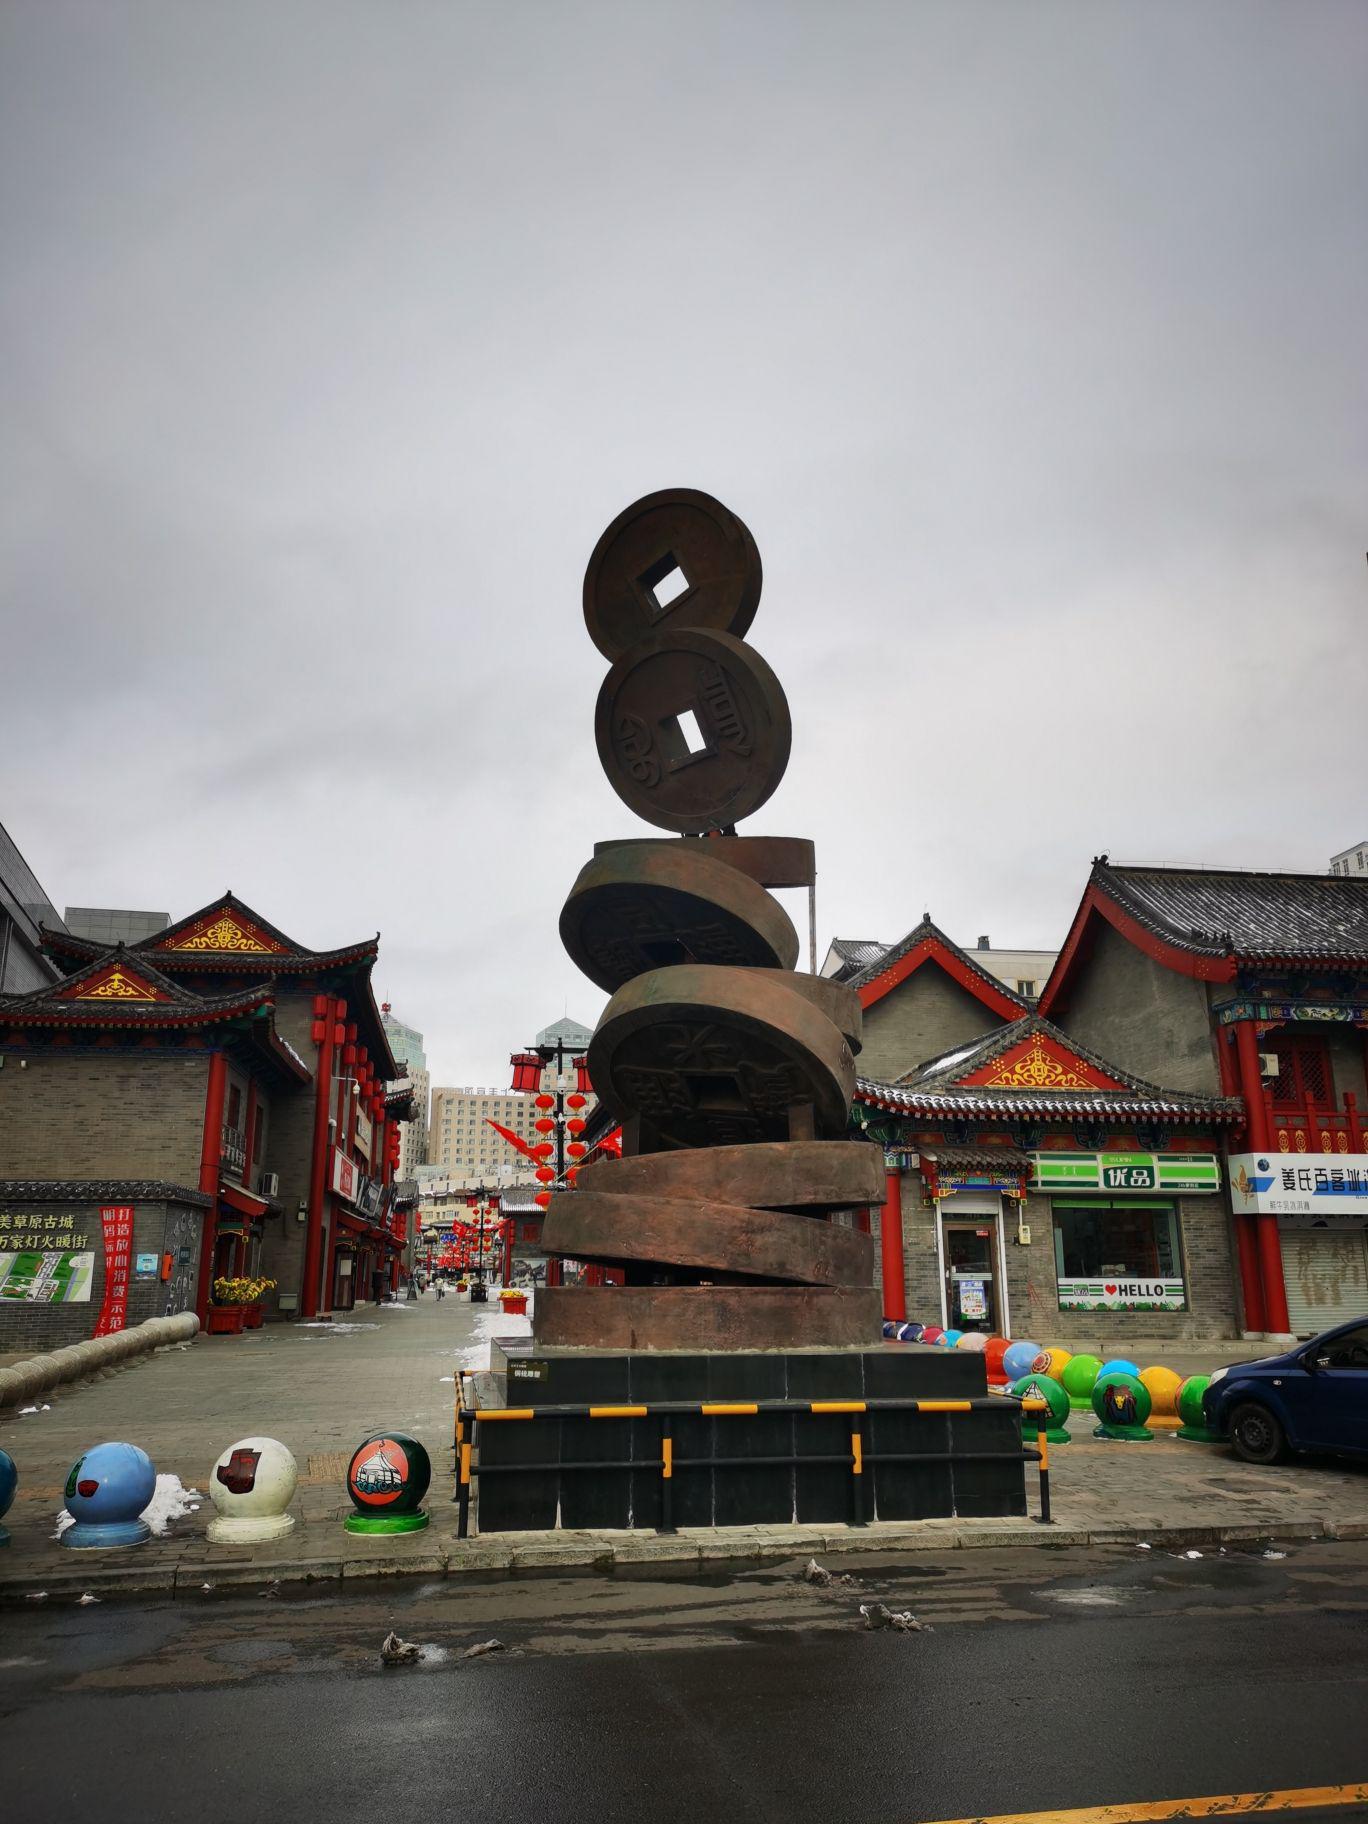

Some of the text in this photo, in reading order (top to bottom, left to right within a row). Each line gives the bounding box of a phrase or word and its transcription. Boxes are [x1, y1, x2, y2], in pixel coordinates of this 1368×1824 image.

[1108, 1168, 1150, 1187] 优品
[1281, 1168, 1368, 1191] 姜氏百客冰
[109, 1208, 131, 1337] 打造放心消费示范
[1119, 1284, 1164, 1296] HELLO
